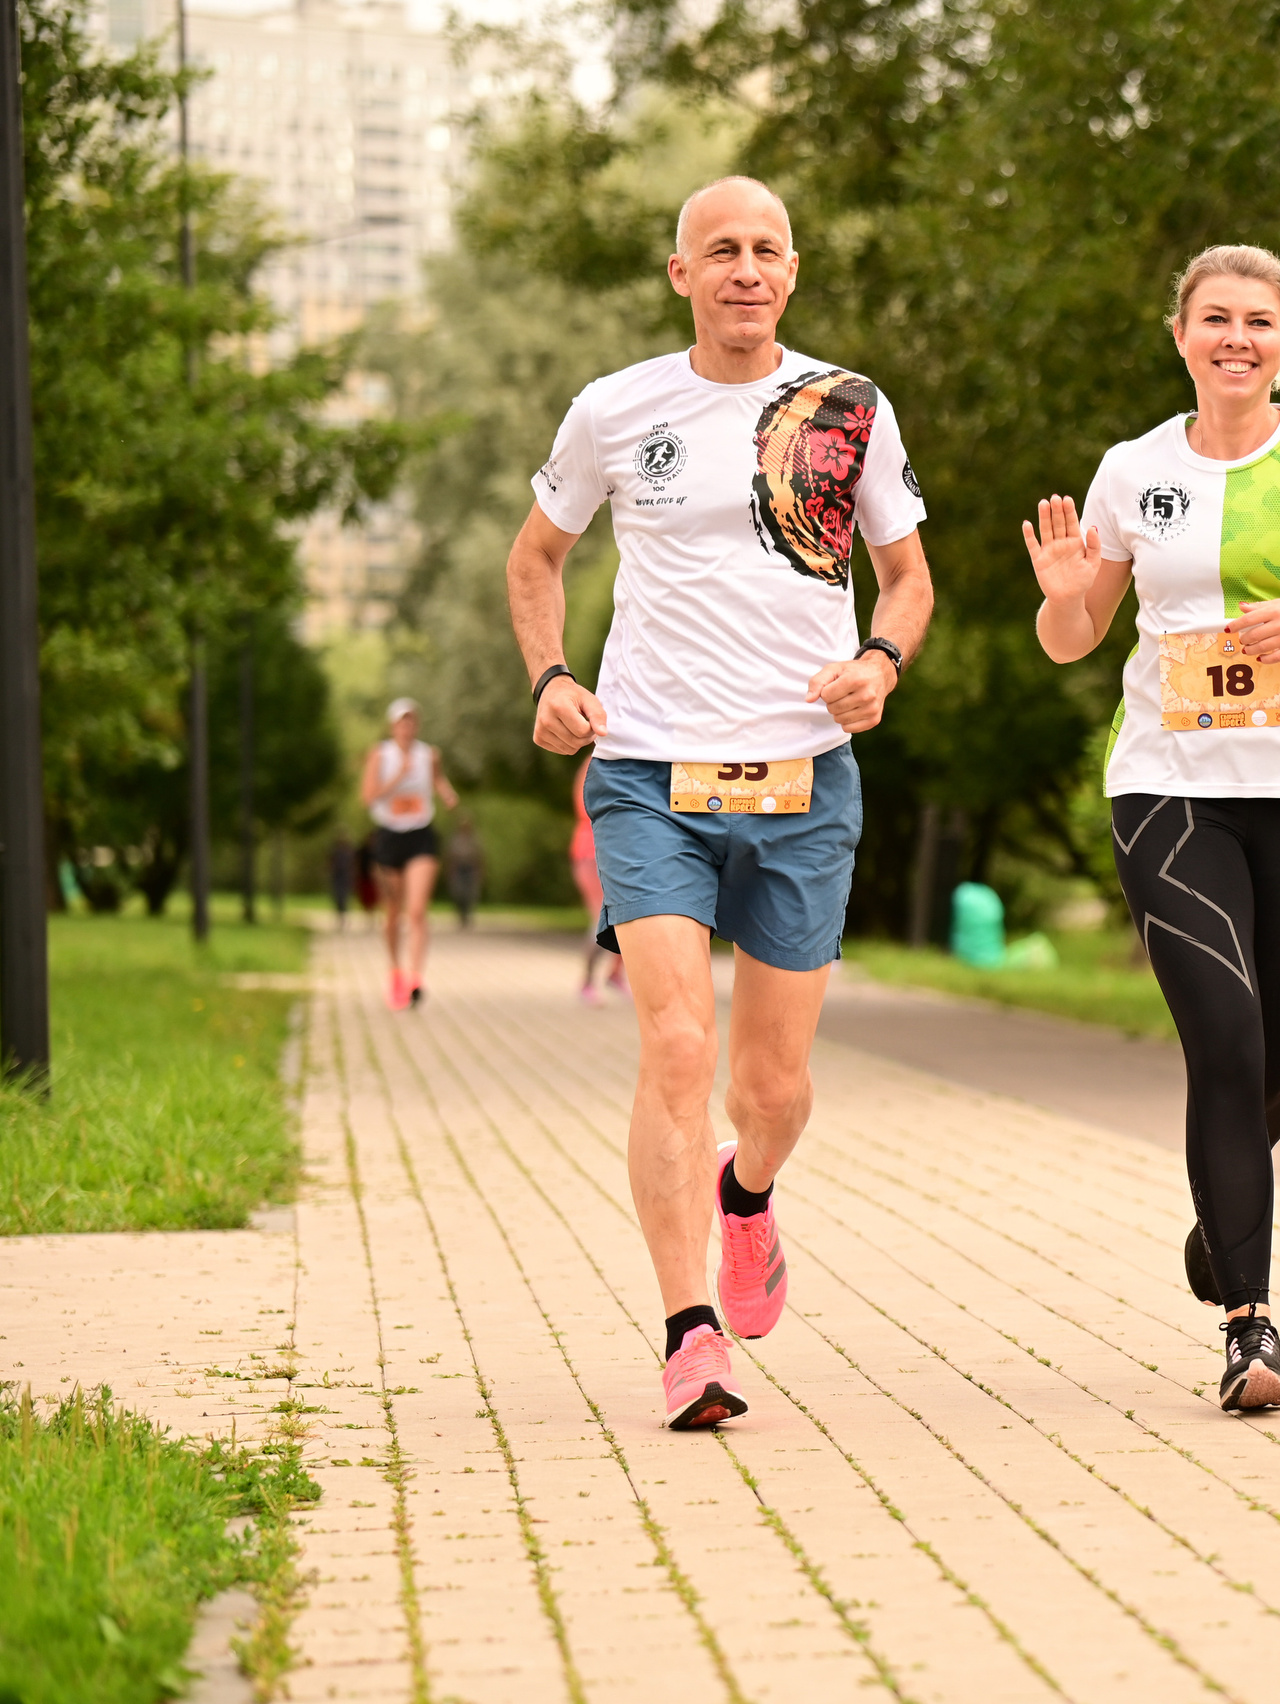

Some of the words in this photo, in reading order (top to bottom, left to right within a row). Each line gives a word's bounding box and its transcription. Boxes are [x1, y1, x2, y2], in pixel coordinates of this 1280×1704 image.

[638, 430, 665, 449] GOLDEN
[667, 431, 683, 446] RING
[636, 470, 659, 485] ULTRA
[662, 467, 683, 484] TRAIL
[635, 498, 655, 507] NEVER
[656, 496, 674, 505] GIVE
[676, 496, 688, 506] UP
[1153, 494, 1174, 520] 5
[1206, 663, 1255, 697] 18
